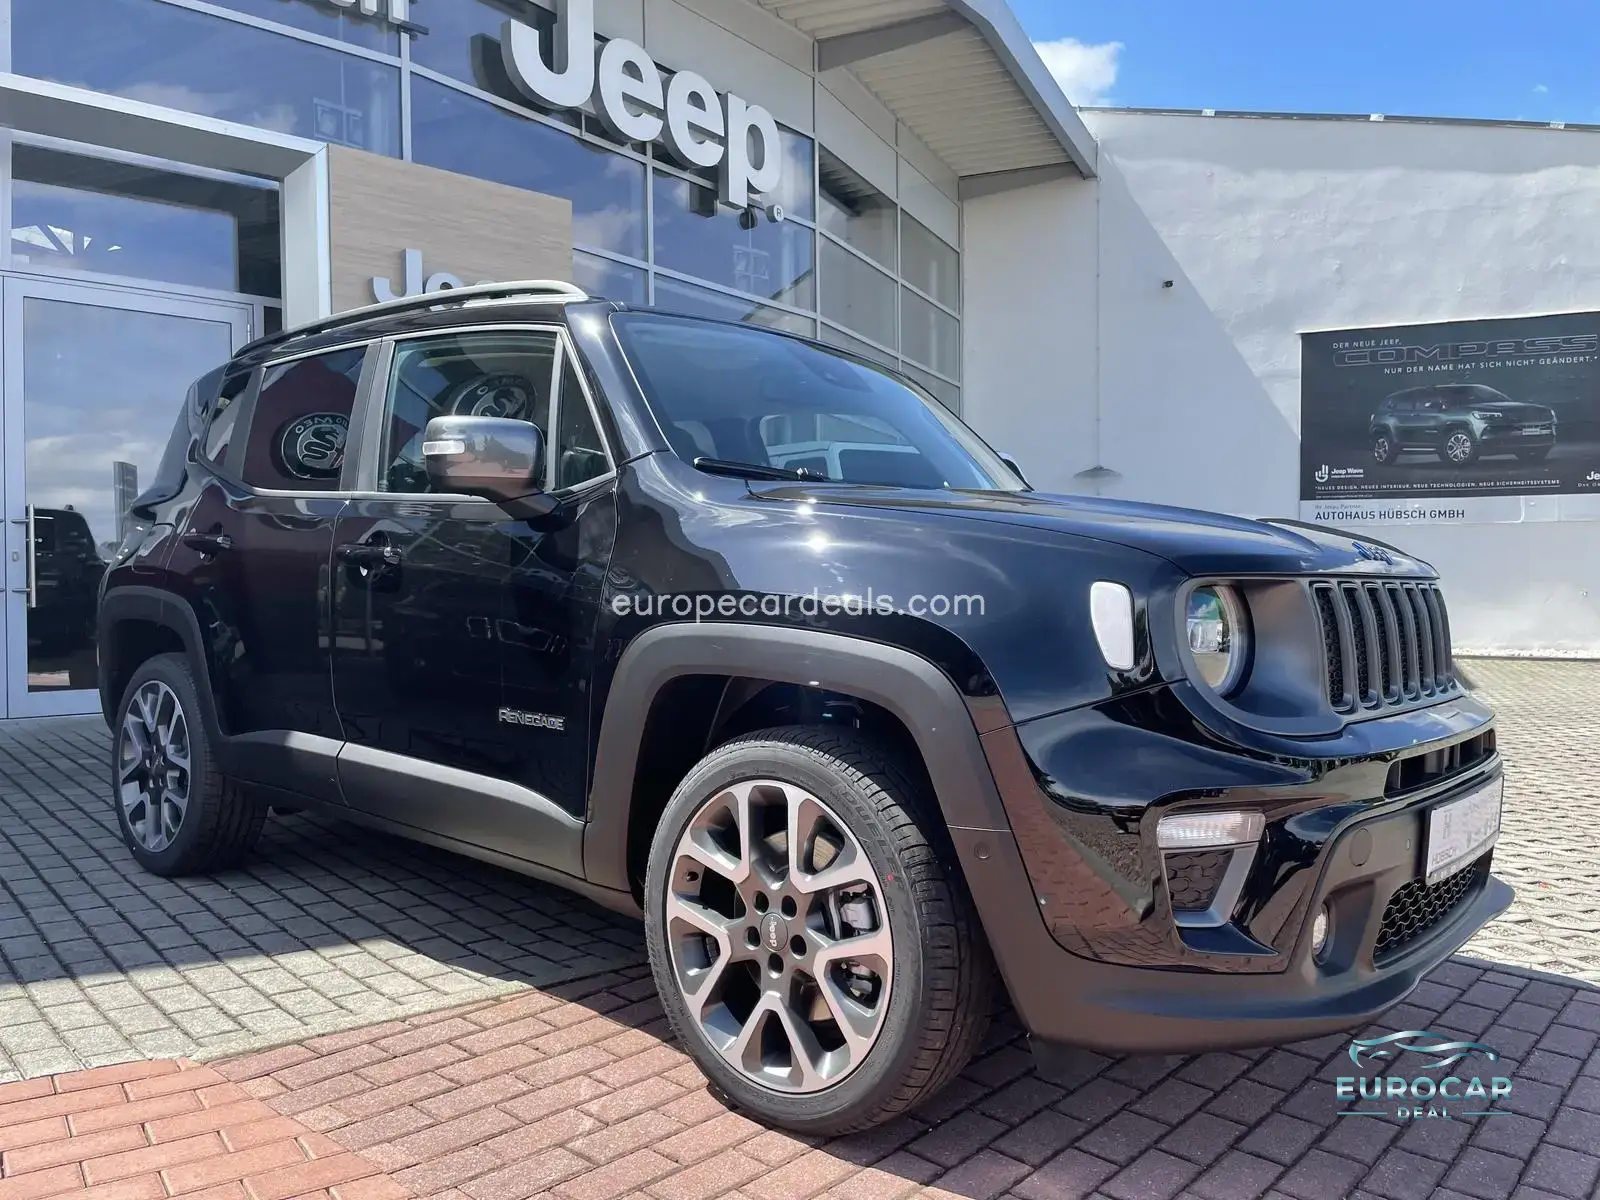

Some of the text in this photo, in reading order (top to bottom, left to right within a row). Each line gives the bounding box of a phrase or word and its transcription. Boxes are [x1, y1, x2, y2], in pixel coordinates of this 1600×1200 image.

[500, 0, 783, 209] Jeep
[1333, 334, 1598, 367] COMPASS
[1353, 340, 1376, 348] NEUE
[1406, 365, 1424, 373] DER
[1427, 363, 1454, 372] NAME
[1458, 362, 1477, 370] HAT
[1480, 361, 1502, 369] SICH
[1506, 359, 1535, 367] NICHT
[1315, 507, 1465, 521] AUTOHAUS HÜBSCH GMBH
[498, 707, 566, 731] RENEGADE
